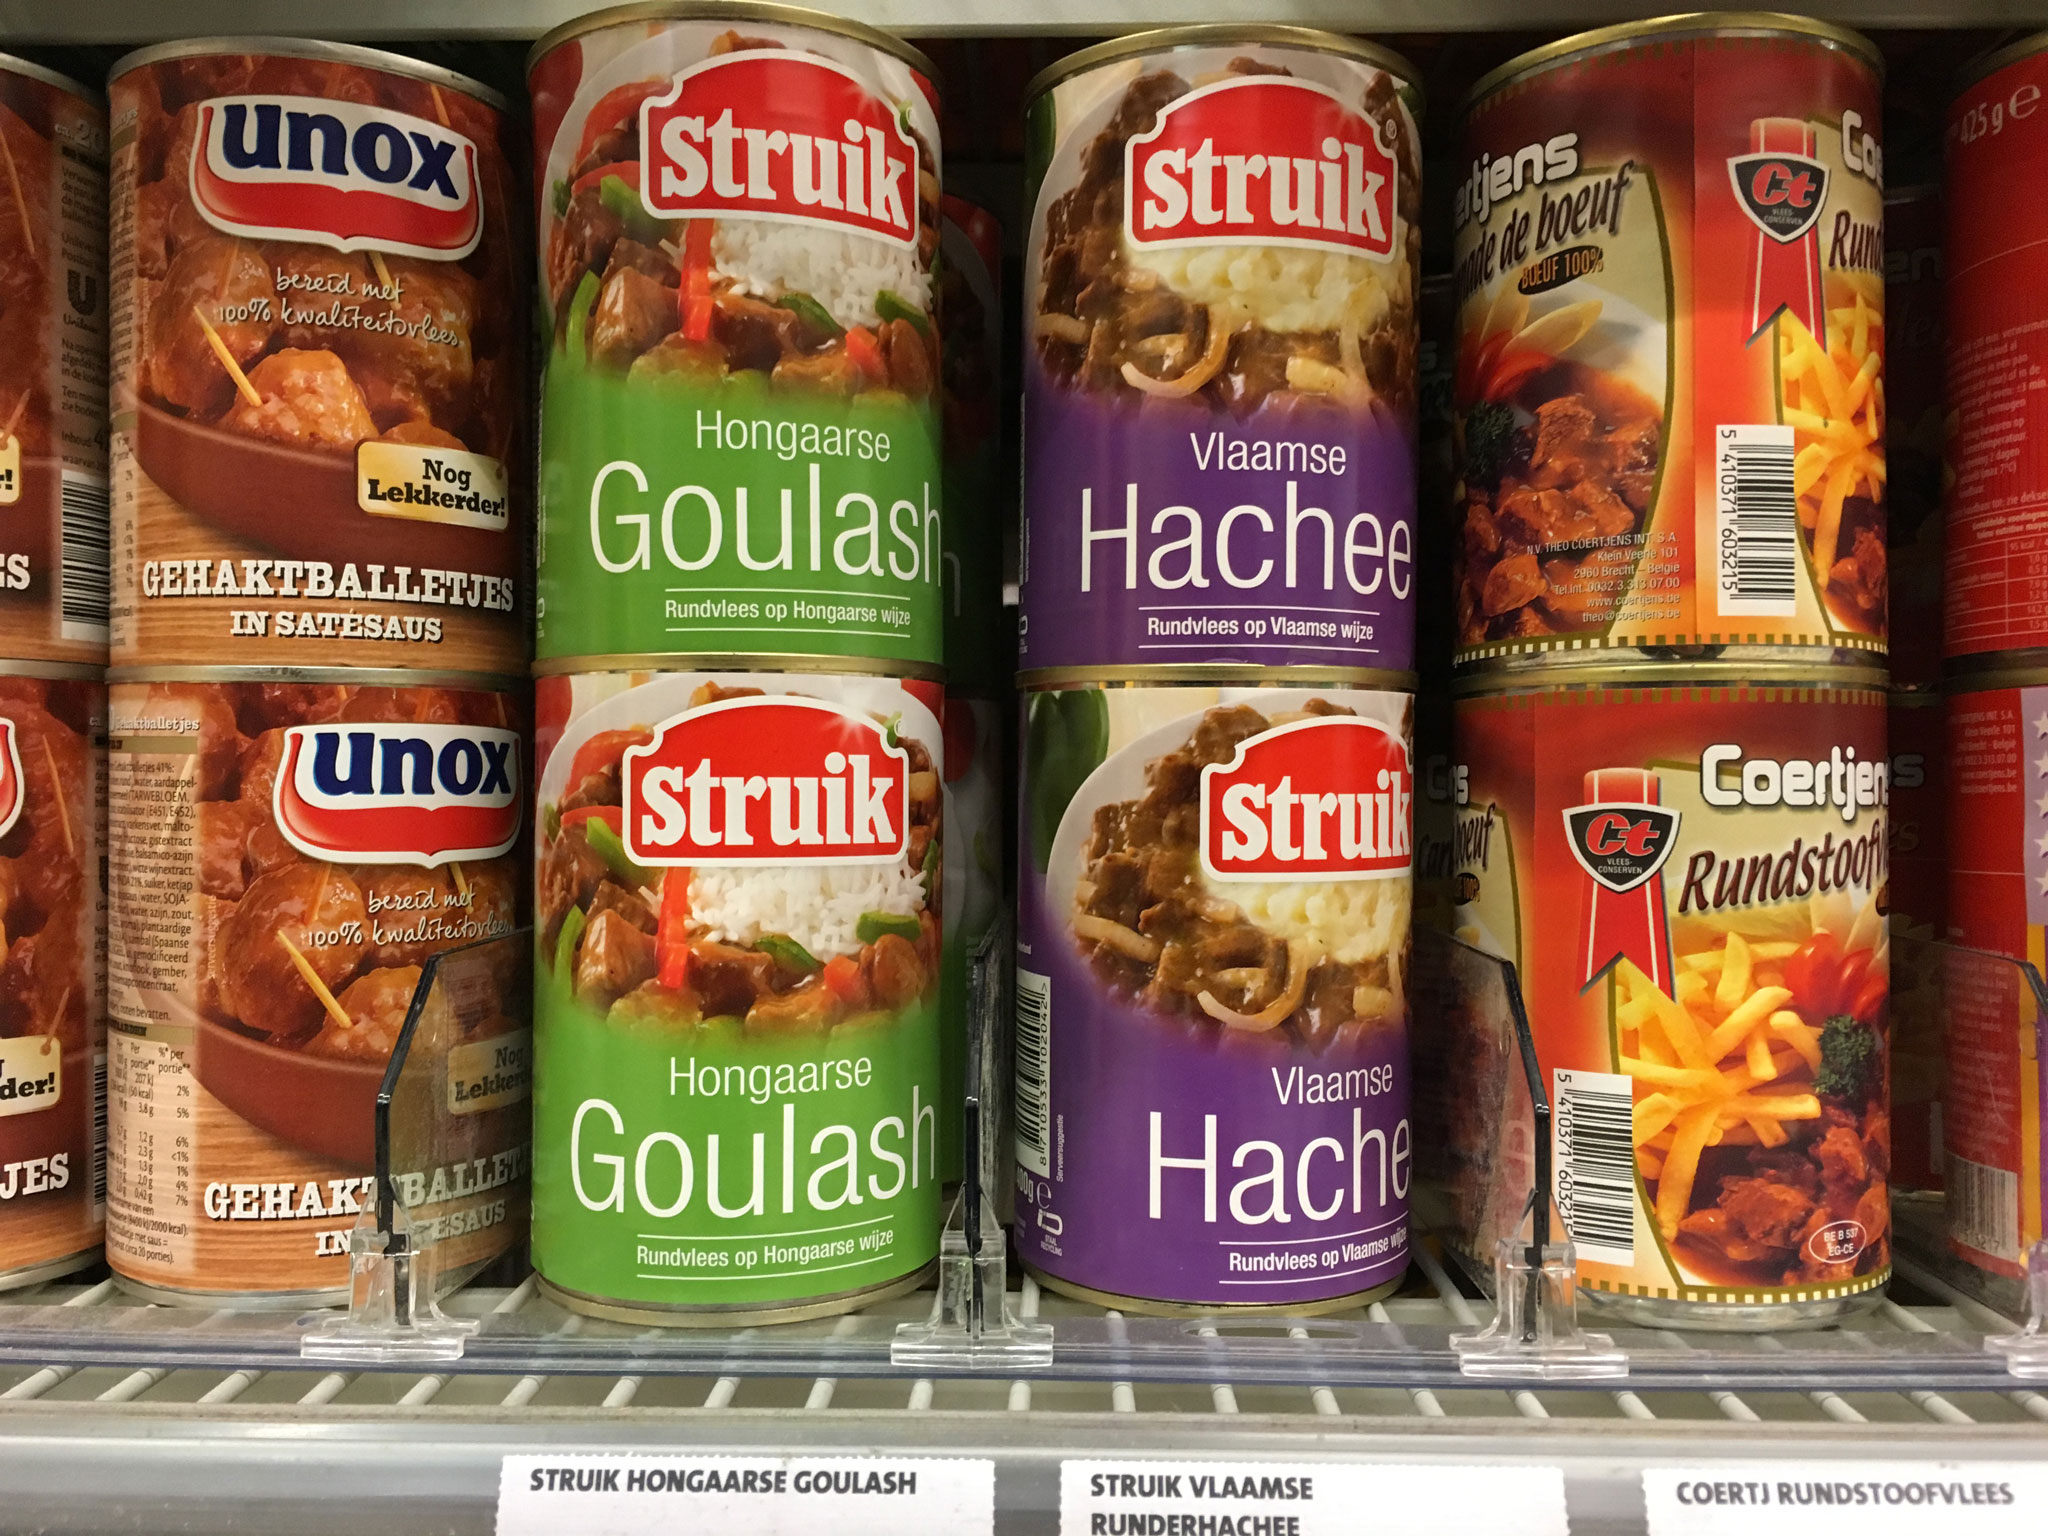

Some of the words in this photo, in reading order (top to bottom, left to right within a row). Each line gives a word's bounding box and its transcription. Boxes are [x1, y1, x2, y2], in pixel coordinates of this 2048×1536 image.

[1960, 102, 1988, 145] 425
[1992, 103, 2004, 136] g
[661, 108, 909, 230] Struik
[1456, 132, 1578, 231] ertjens
[1143, 137, 1387, 243] Struik
[1500, 208, 1530, 270] de
[1535, 160, 1634, 251] boeuf
[1521, 255, 1559, 289] BOEUF
[1565, 247, 1604, 278] 100%
[276, 267, 356, 294] bereid
[362, 278, 404, 301] met
[220, 298, 271, 322] 100%
[696, 409, 891, 462] Hongaarse
[1721, 429, 1736, 439] 5
[1189, 431, 1347, 476] Vlaamse
[422, 458, 471, 491] Nog
[1721, 453, 1737, 514] 410371
[368, 478, 505, 517] Lekkerder!
[589, 461, 942, 588] Goulash
[1082, 480, 1412, 601] Hachee
[1545, 541, 1570, 553] THEO
[1571, 535, 1631, 550] COERTJENS
[1597, 549, 1622, 562] Klein
[1624, 548, 1656, 560] Veerle
[1661, 547, 1679, 557] 101
[1721, 527, 1738, 591] 603215
[1601, 564, 1635, 577] Brecht
[142, 557, 513, 612] GEHAKTBALLETJES
[665, 599, 760, 619] Rundvlees
[765, 603, 787, 622] op
[794, 601, 877, 624] Hongaarse
[881, 606, 911, 628] wijze
[1586, 594, 1680, 609] www.coertjens.be
[231, 611, 268, 636] IN
[1148, 616, 1239, 636] Rundvlees
[1244, 620, 1266, 639] op
[1271, 616, 1337, 637] Vlaamse
[1341, 620, 1374, 643] wijze
[1582, 610, 1680, 624] theo@coertjens.be
[154, 776, 197, 790] aardappel-
[641, 751, 897, 847] Struik
[164, 820, 194, 832] malto-
[1222, 769, 1411, 863] Struik
[149, 836, 192, 848] gistextract
[1598, 865, 1643, 875] CONSERVEN
[1607, 857, 1633, 866] VLEES-
[163, 893, 190, 905] SOJA-
[167, 880, 193, 893] ketjap
[369, 888, 439, 914] bereid
[443, 883, 477, 907] met
[171, 909, 194, 921] zout,
[141, 921, 191, 937] plantaardige
[308, 921, 363, 947] 100%
[152, 935, 189, 949] (Spaanse
[133, 950, 189, 965] gemodificeerd
[153, 967, 187, 980] gember,
[136, 1007, 171, 1021] bevatten.
[1040, 999, 1049, 1064] 102042
[131, 1042, 140, 1054] Per
[170, 1050, 184, 1061] per
[670, 1055, 873, 1105] Hongaarse
[1272, 1066, 1393, 1106] Vlaamse
[1558, 1073, 1572, 1083] 5
[177, 1085, 189, 1097] 2%
[177, 1107, 189, 1119] 5%
[1040, 1079, 1048, 1147] 710533
[1558, 1096, 1573, 1157] 410371
[176, 1136, 189, 1148] 6%
[570, 1084, 935, 1219] Goulash
[177, 1165, 188, 1177] 1%
[1040, 1156, 1047, 1166] 8
[1150, 1107, 1411, 1226] Hache
[176, 1180, 188, 1192] 4%
[175, 1195, 188, 1206] 7%
[147, 1235, 161, 1247] saus
[1824, 1230, 1836, 1242] BE
[1838, 1230, 1844, 1241] B
[1846, 1227, 1859, 1239] 537
[146, 1247, 174, 1265] porties).
[637, 1245, 729, 1267] Rundvlees
[735, 1250, 758, 1269] op
[764, 1238, 854, 1265] Hongaarse
[859, 1229, 894, 1252] wijze
[1229, 1252, 1317, 1272] Rundvlees
[1322, 1250, 1339, 1269] op
[1342, 1237, 1389, 1263] Vlaamse
[1828, 1243, 1854, 1256] EG-CE
[530, 1468, 620, 1492] STRUIK
[627, 1469, 787, 1494] HONGAARSE
[794, 1471, 917, 1495] GOULASH
[1090, 1474, 1182, 1498] STRUIK
[1189, 1475, 1313, 1500] VLAAMSE
[1676, 1481, 1771, 1506] COERTJ
[1778, 1482, 2015, 1507] RUNDSTOOFVLEES
[1091, 1513, 1300, 1536] RUNDERHACHEE
